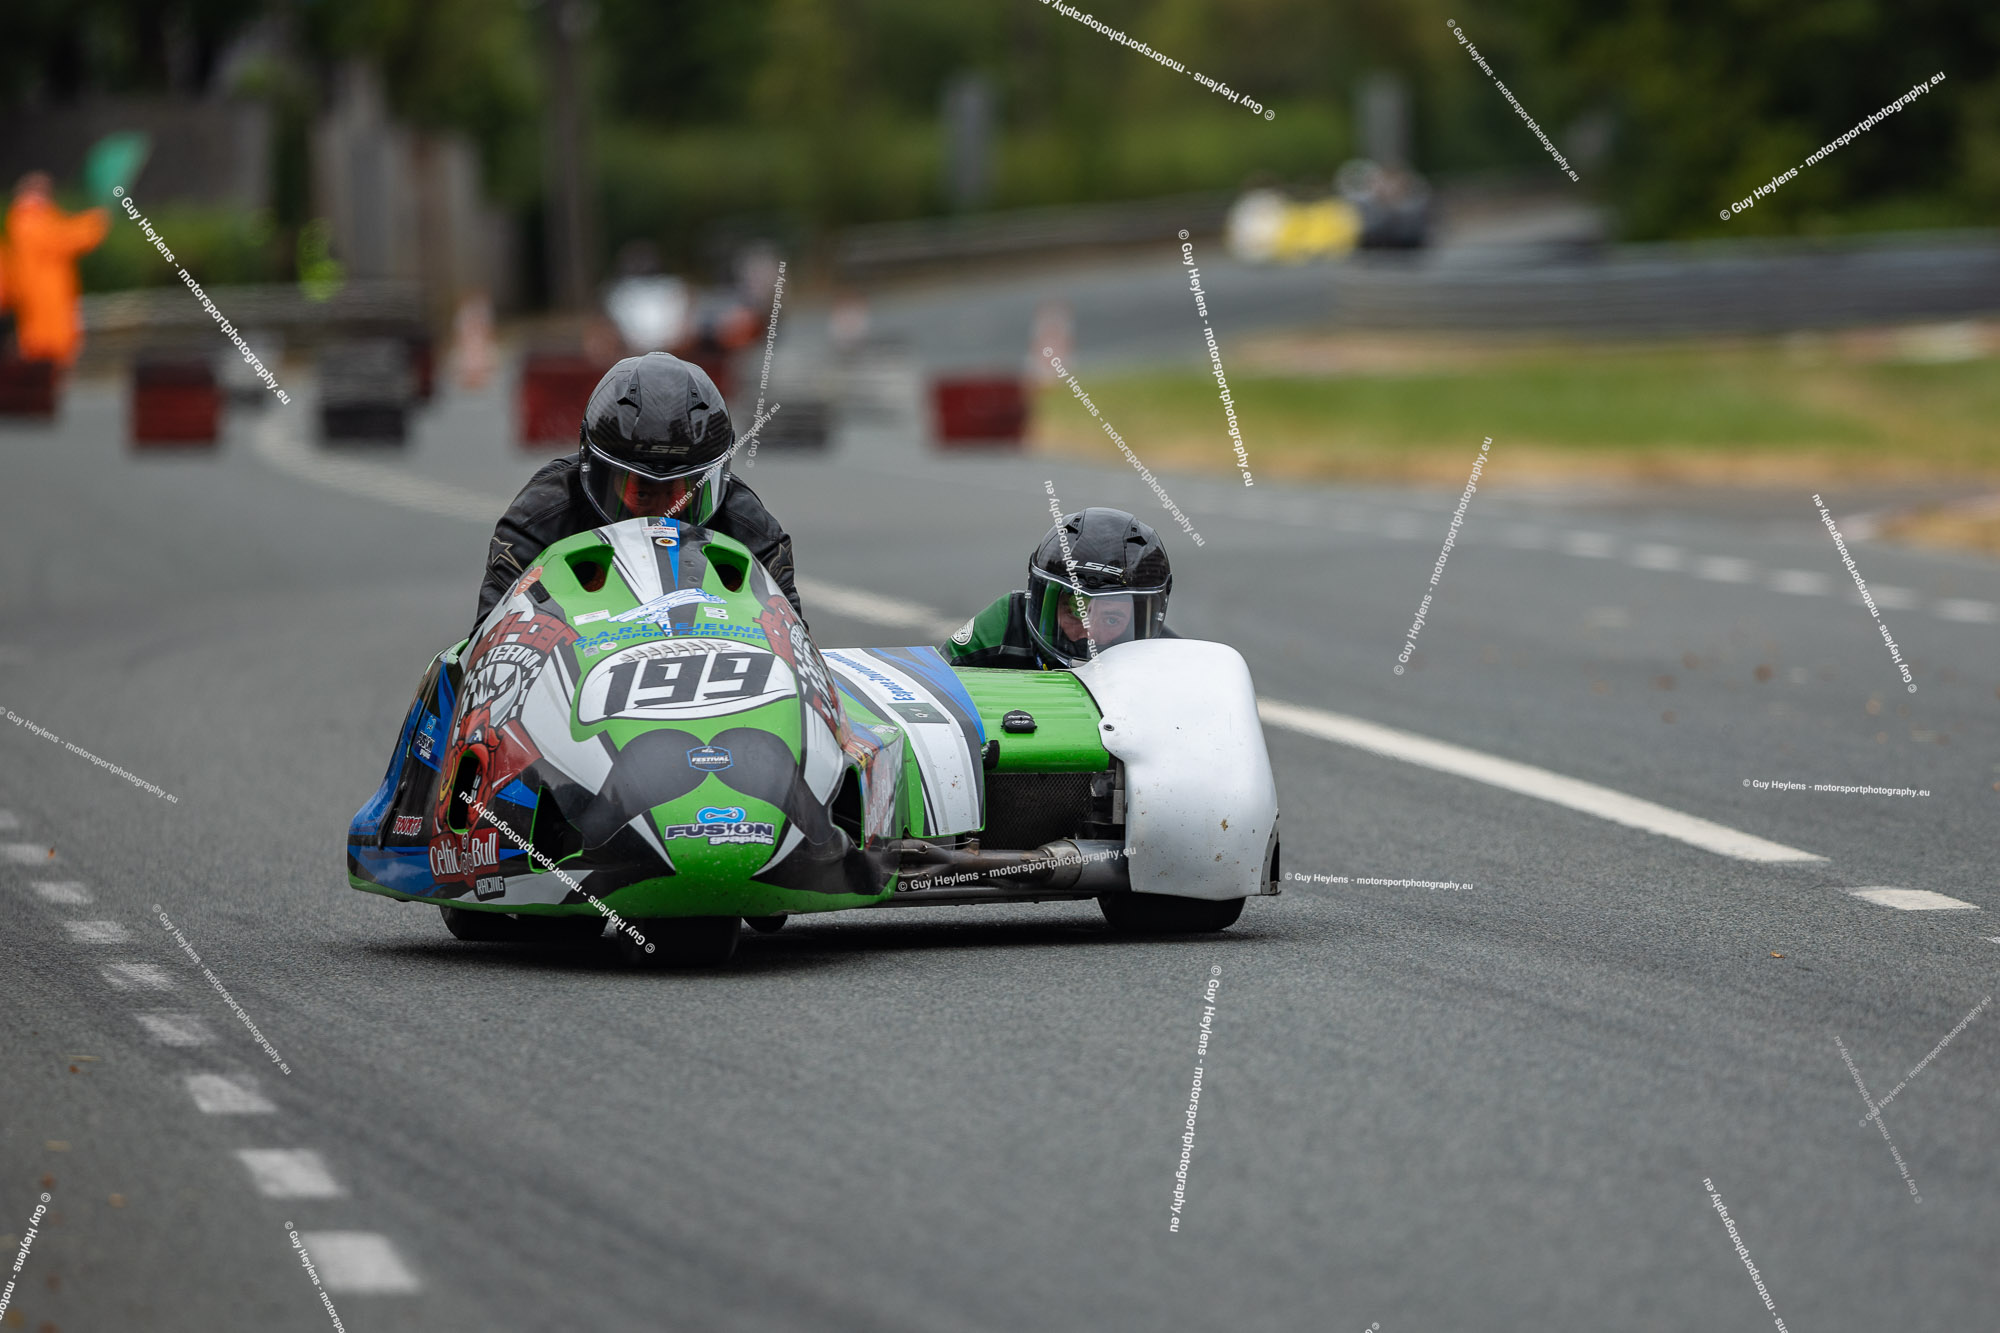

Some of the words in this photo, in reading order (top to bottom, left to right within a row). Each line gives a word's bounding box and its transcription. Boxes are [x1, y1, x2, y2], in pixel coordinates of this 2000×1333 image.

[662, 622, 766, 636] LEJEUNE
[578, 631, 672, 650] TRANSPORT
[679, 630, 767, 641] FORESTIER
[485, 644, 542, 669] TEAM
[603, 652, 776, 716] 199
[665, 822, 775, 840] FUSION
[430, 838, 462, 876] Celtic
[471, 832, 498, 867] Bull
[476, 875, 505, 896] RACING
